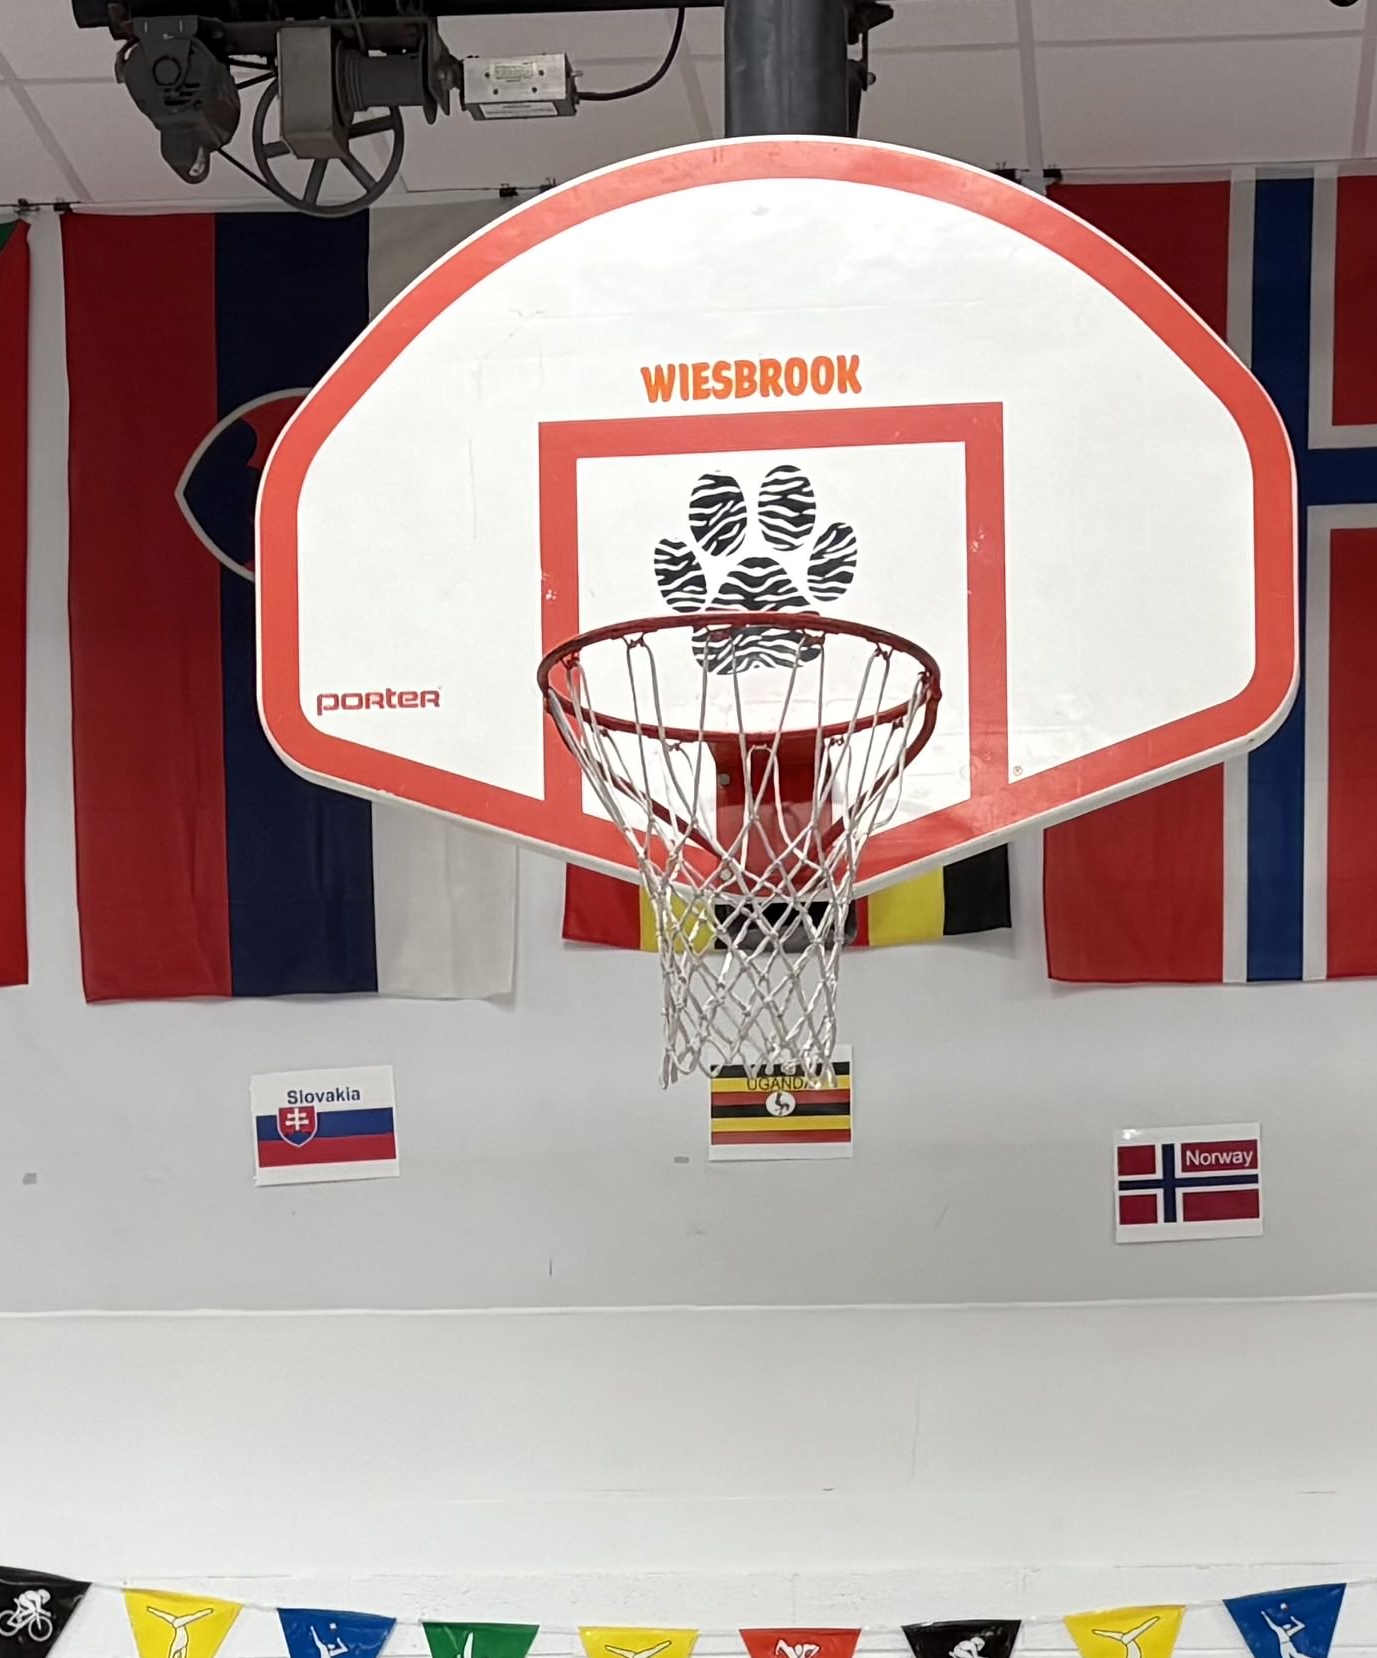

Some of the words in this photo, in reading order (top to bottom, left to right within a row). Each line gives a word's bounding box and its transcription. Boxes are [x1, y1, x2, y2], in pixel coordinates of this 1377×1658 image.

[640, 354, 862, 403] WIESBROOK
[287, 1086, 361, 1105] Slovakia
[1185, 1150, 1253, 1167] Norway
